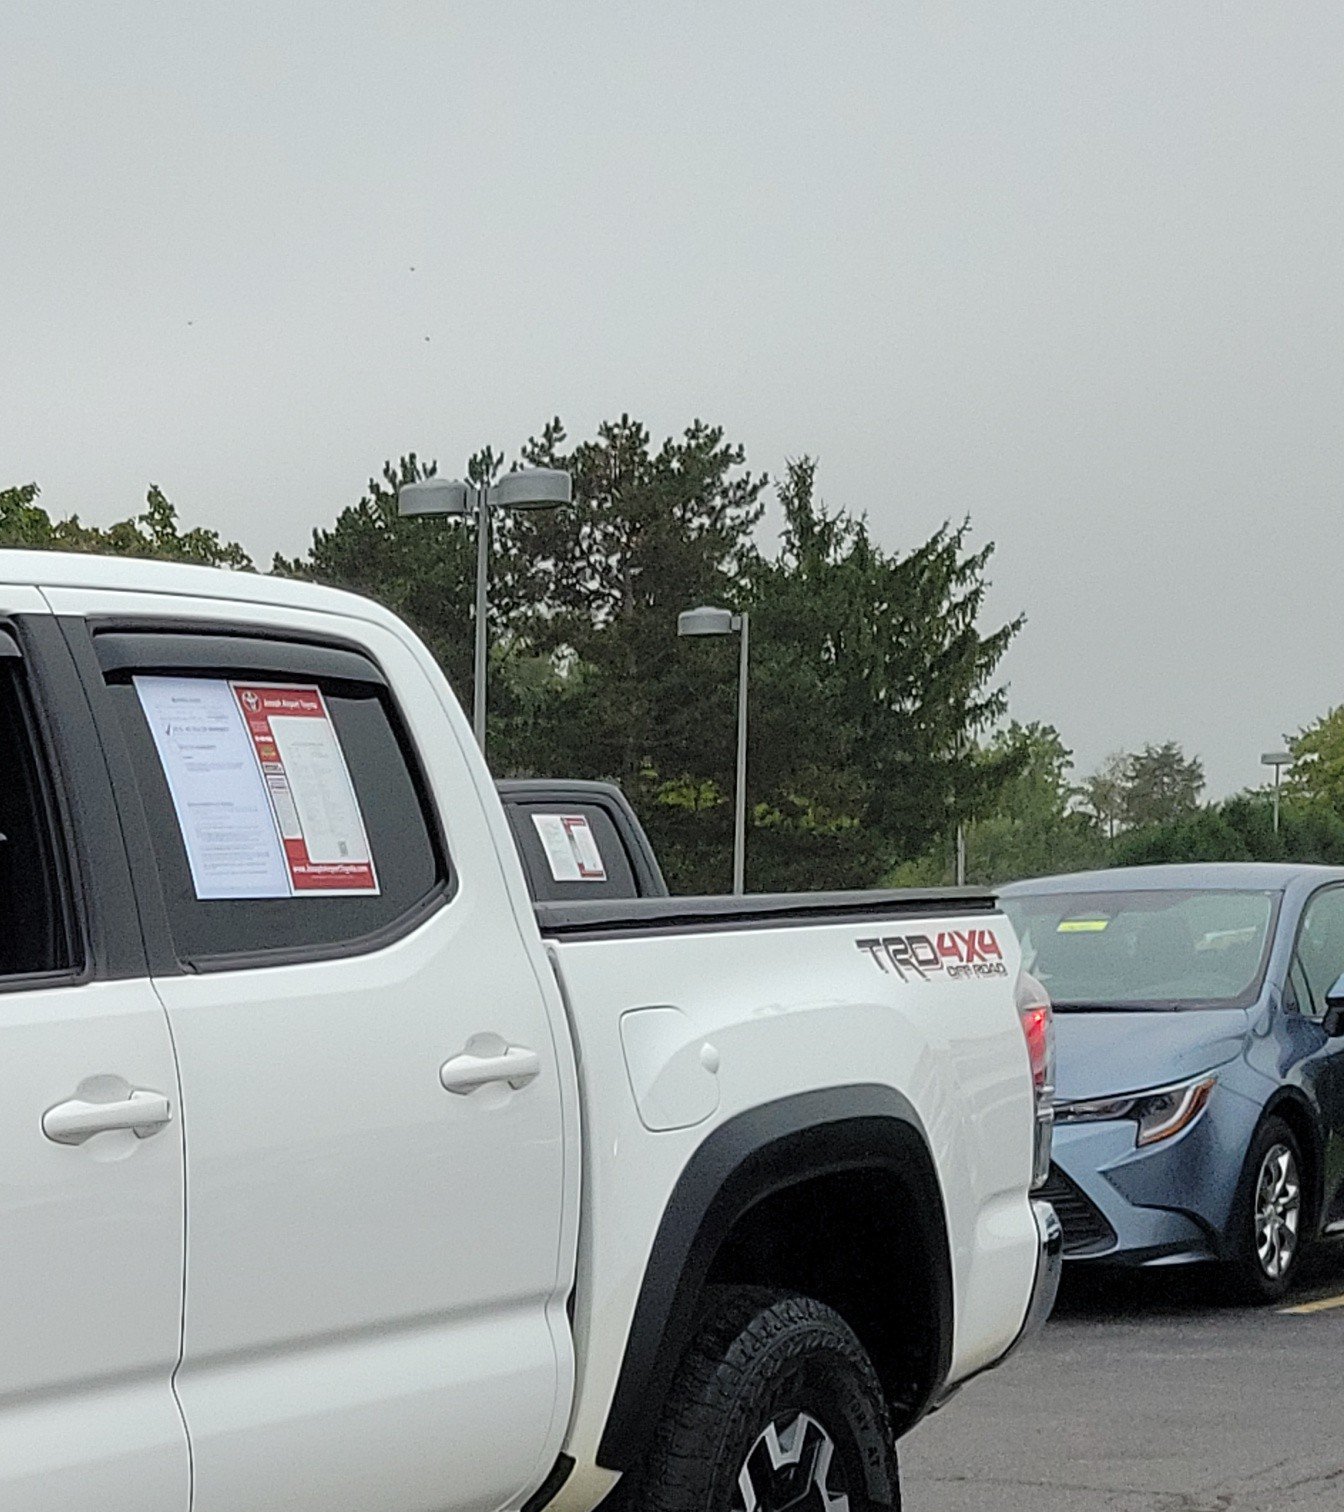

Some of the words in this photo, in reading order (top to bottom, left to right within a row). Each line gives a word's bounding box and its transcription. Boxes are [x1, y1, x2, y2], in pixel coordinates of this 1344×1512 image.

[855, 935, 943, 982] TRD
[946, 964, 972, 979] OFF
[972, 962, 1008, 979] ROAD
